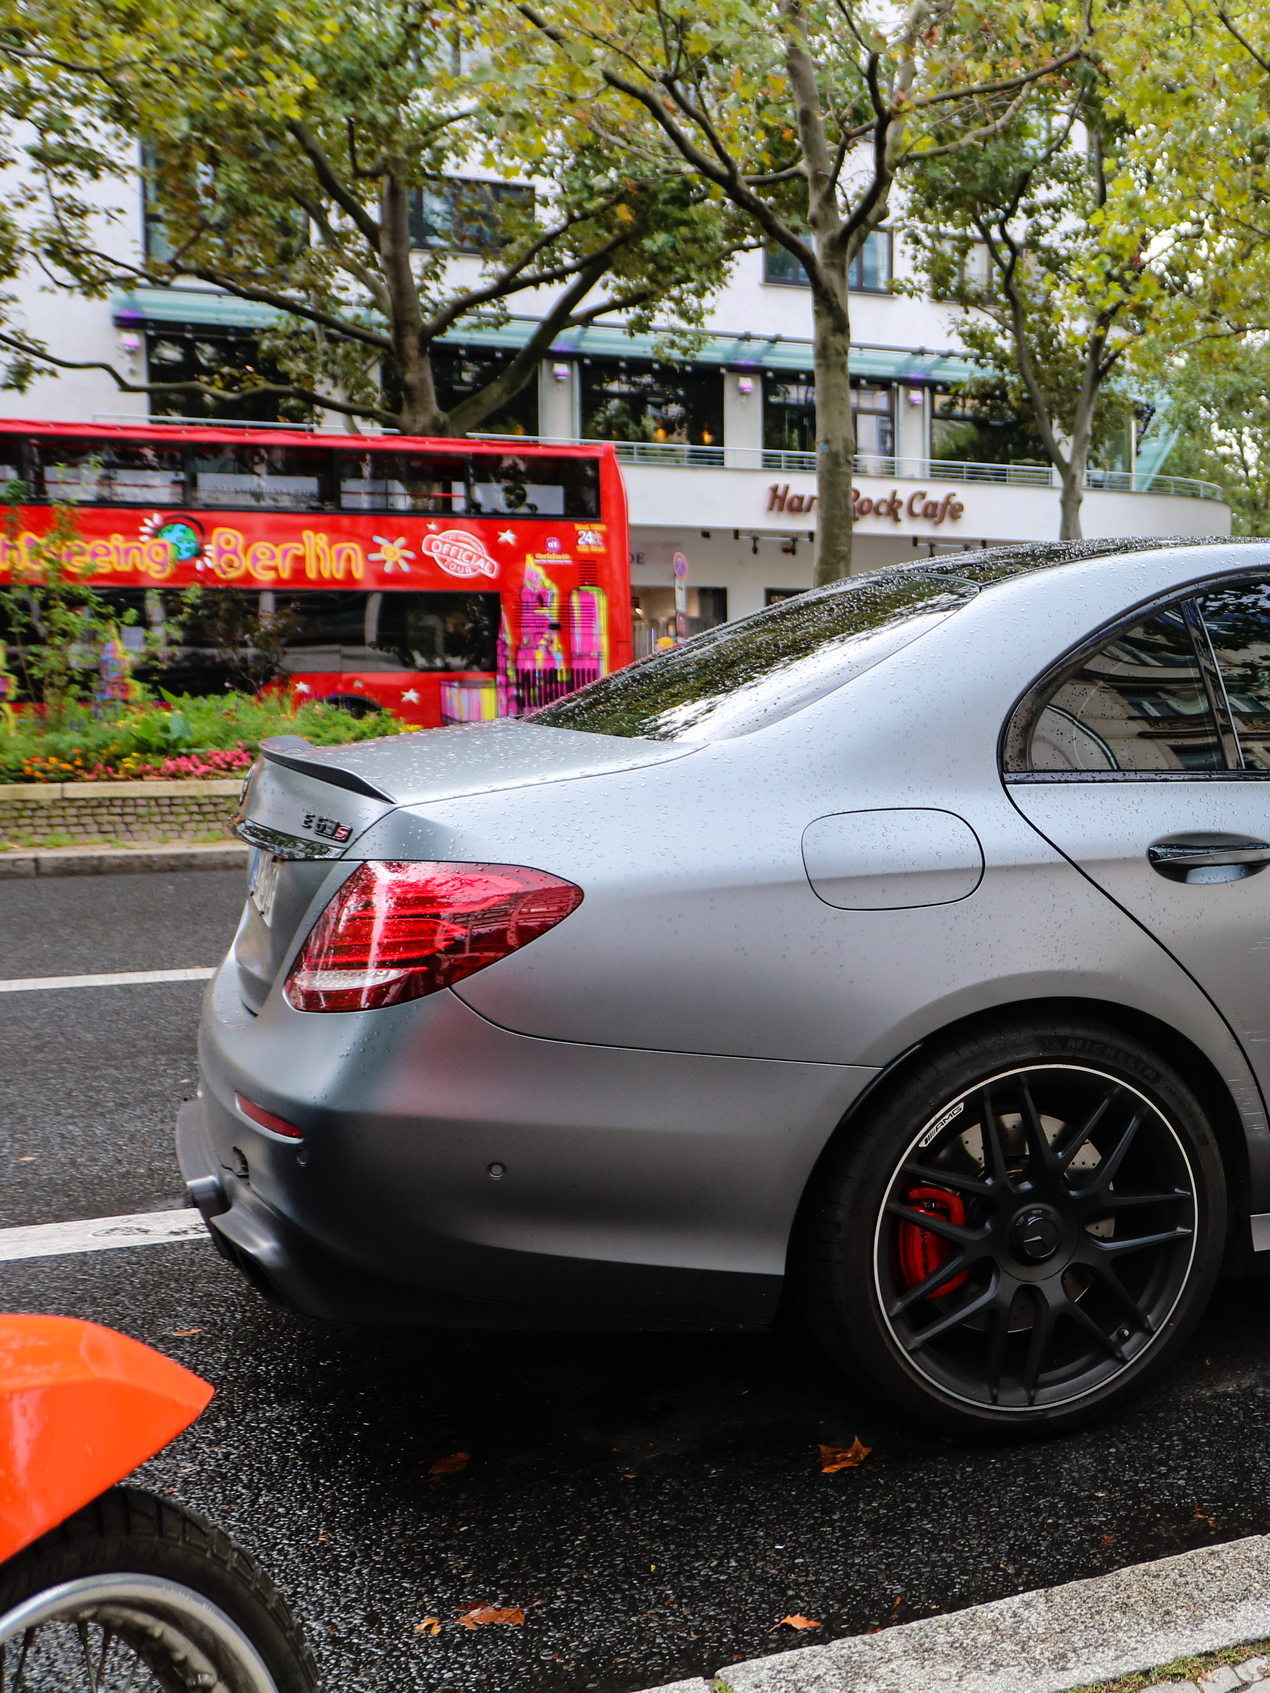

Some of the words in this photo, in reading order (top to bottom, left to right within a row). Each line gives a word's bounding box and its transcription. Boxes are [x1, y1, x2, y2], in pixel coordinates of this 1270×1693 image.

[766, 483, 820, 513] Har
[906, 490, 965, 525] Cafe
[211, 526, 364, 581] Berlin
[431, 540, 491, 573] OFFICIAL
[444, 559, 473, 574] TOUR
[1067, 1038, 1157, 1080] MICHELIN
